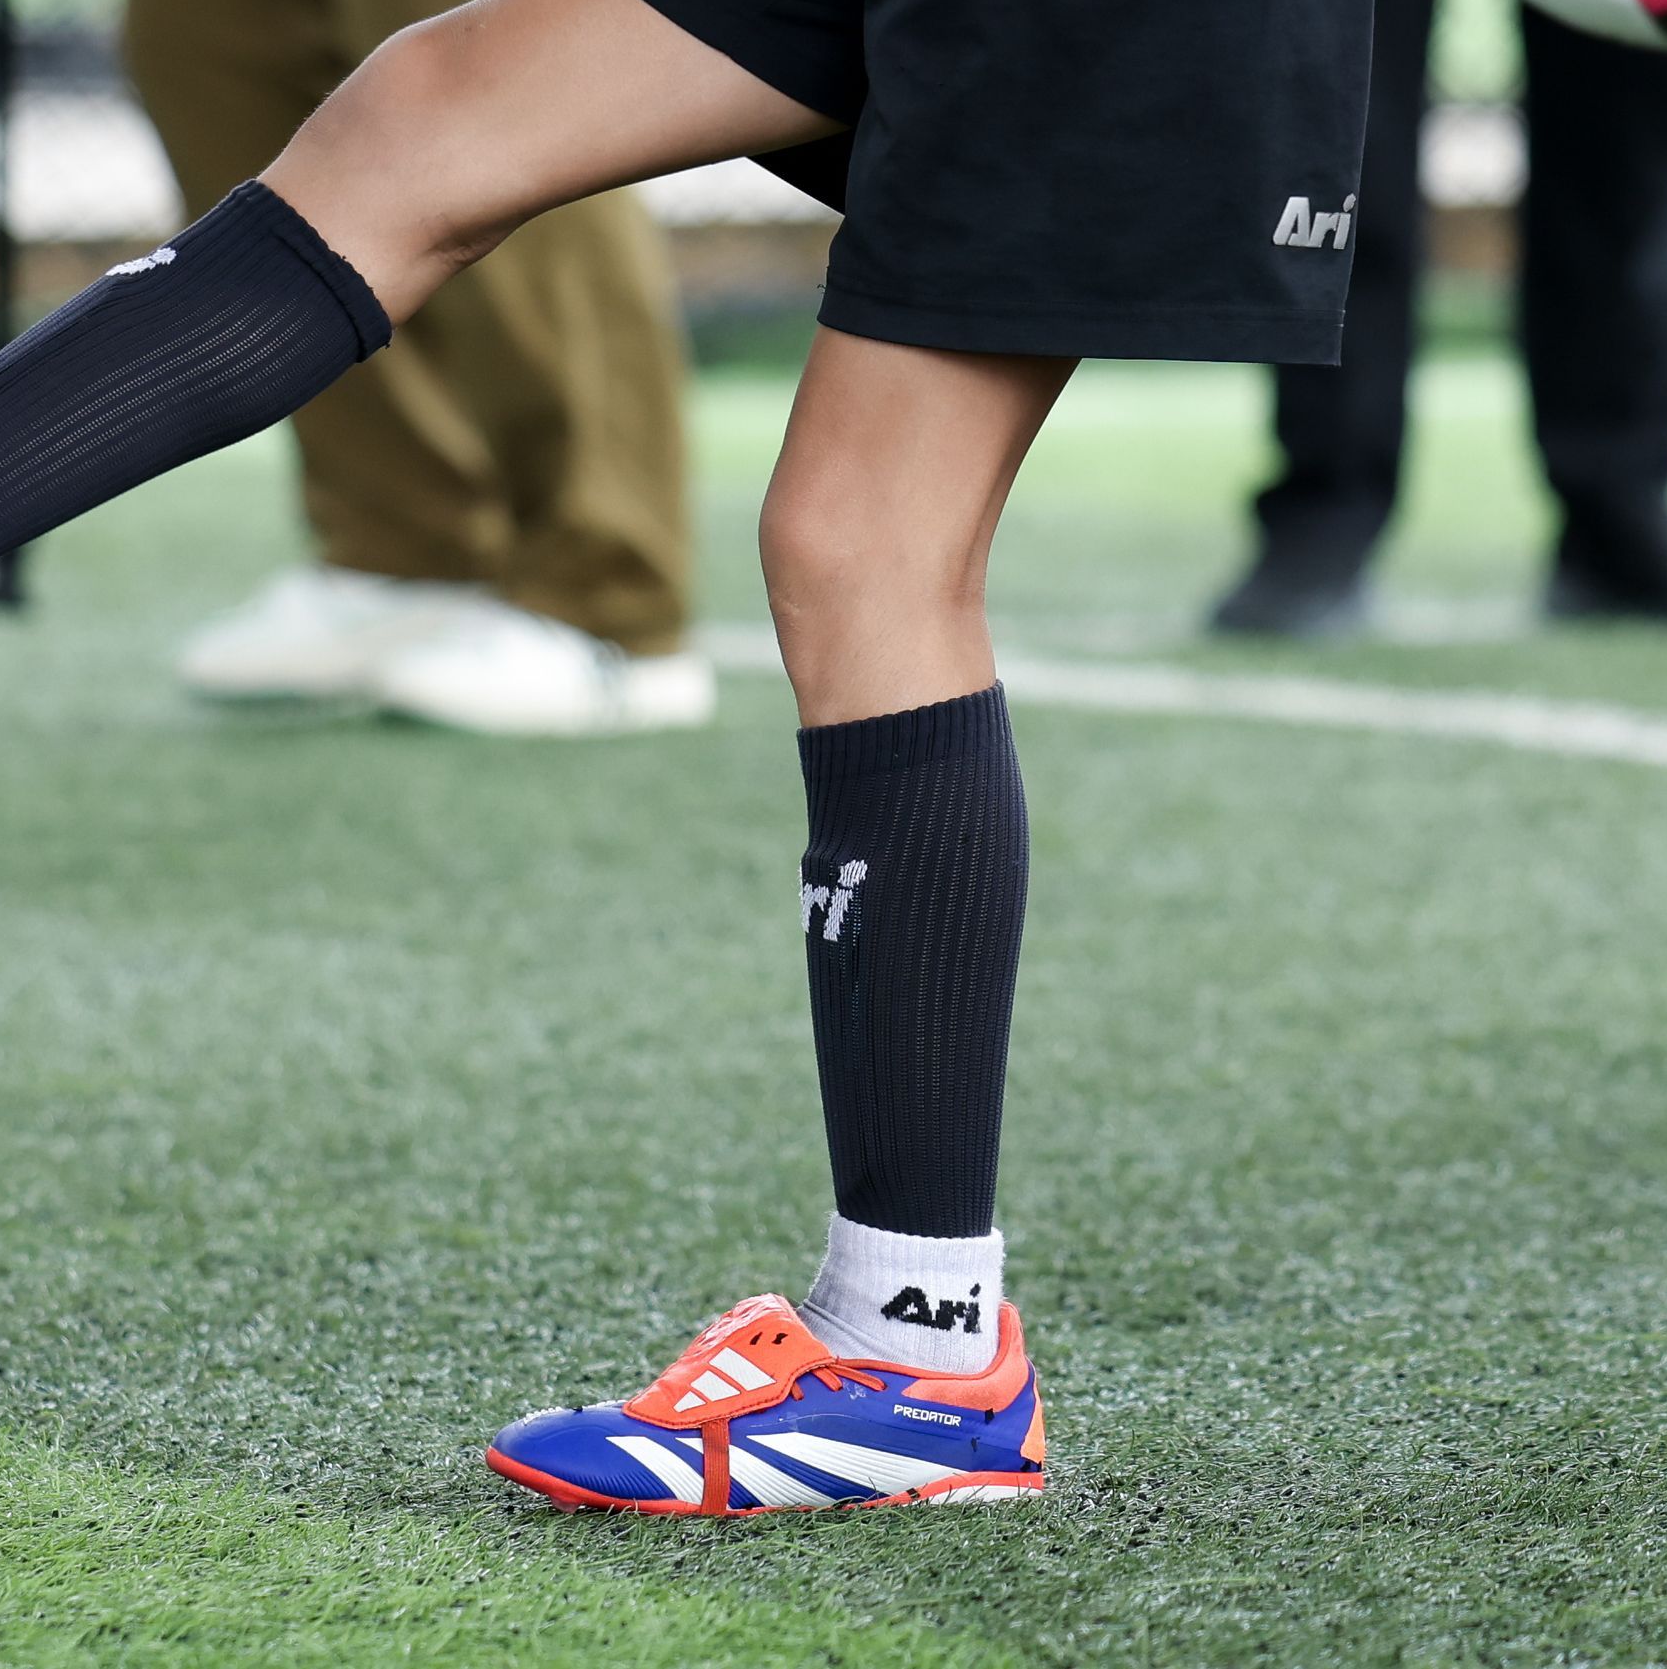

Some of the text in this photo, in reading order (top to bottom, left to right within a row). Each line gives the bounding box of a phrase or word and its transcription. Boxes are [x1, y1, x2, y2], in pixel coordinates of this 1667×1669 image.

[1272, 193, 1357, 250] Ari
[798, 859, 868, 941] ri
[880, 1282, 982, 1334] Ari
[893, 1403, 963, 1428] PREDATOR
